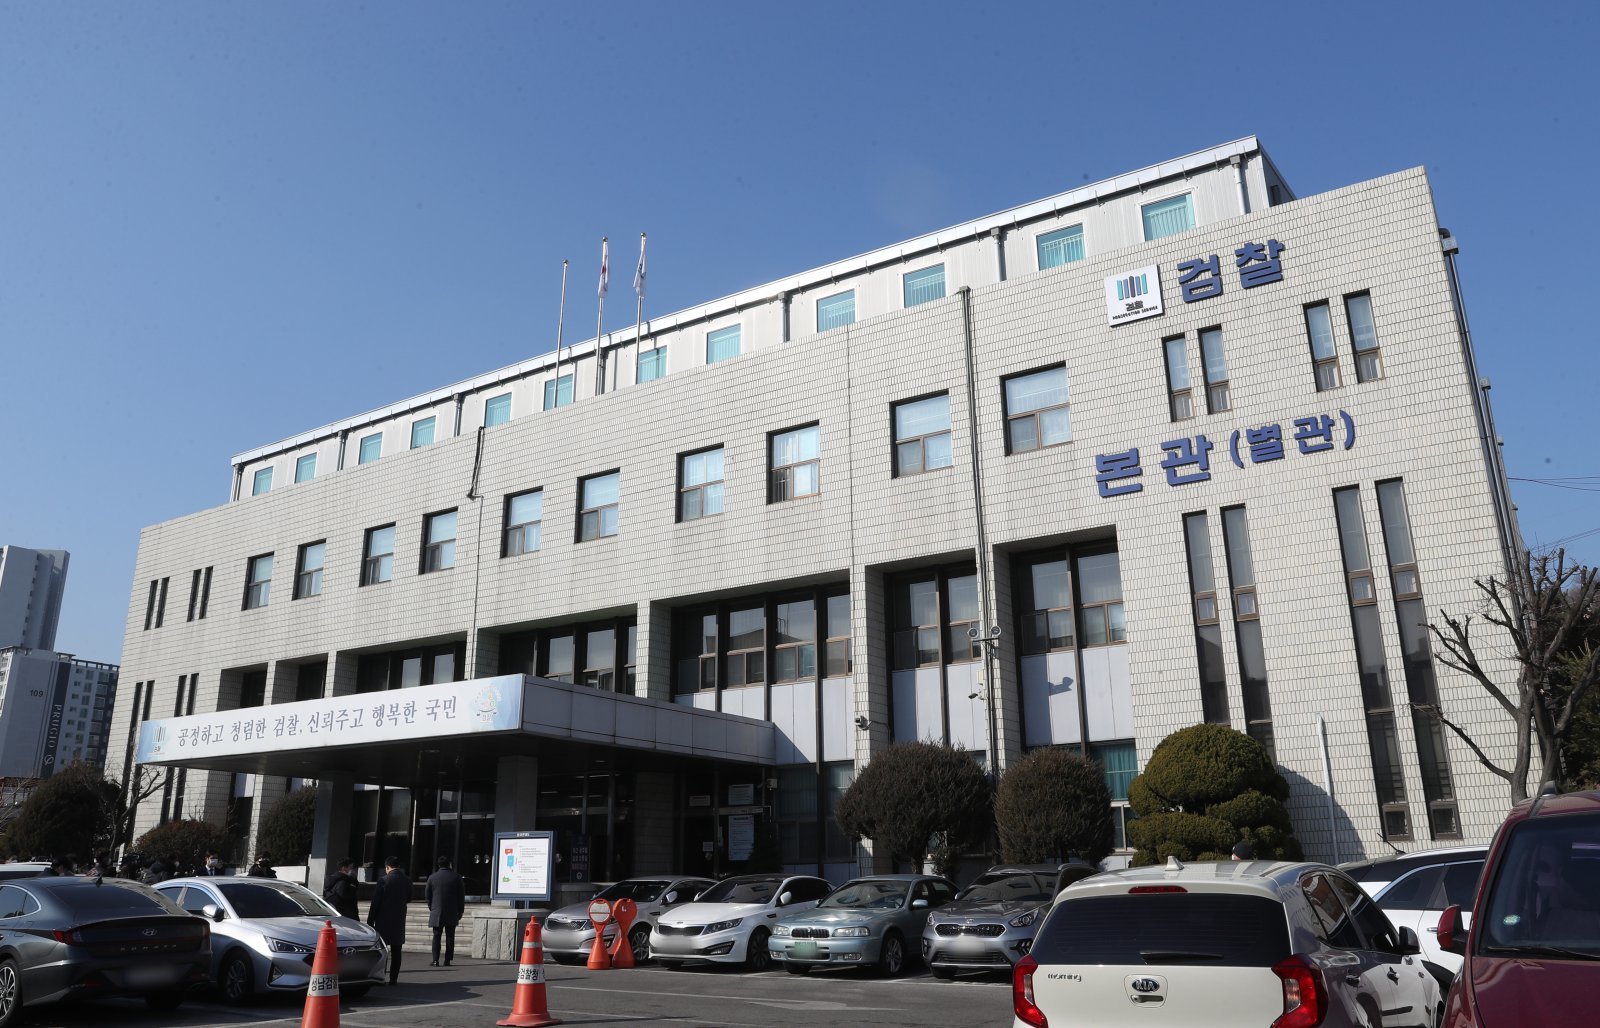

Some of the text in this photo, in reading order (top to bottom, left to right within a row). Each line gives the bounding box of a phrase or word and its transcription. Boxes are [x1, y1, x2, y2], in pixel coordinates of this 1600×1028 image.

[1177, 239, 1286, 303] 검찰
[1095, 409, 1355, 498] 본관 (별관)
[30, 689, 44, 698] 109
[47, 704, 62, 748] PRUGIO
[178, 695, 457, 747] 공정하고 청렴한 검찰, 신뢰주고 행복한 국민
[1133, 979, 1158, 992] KIA
